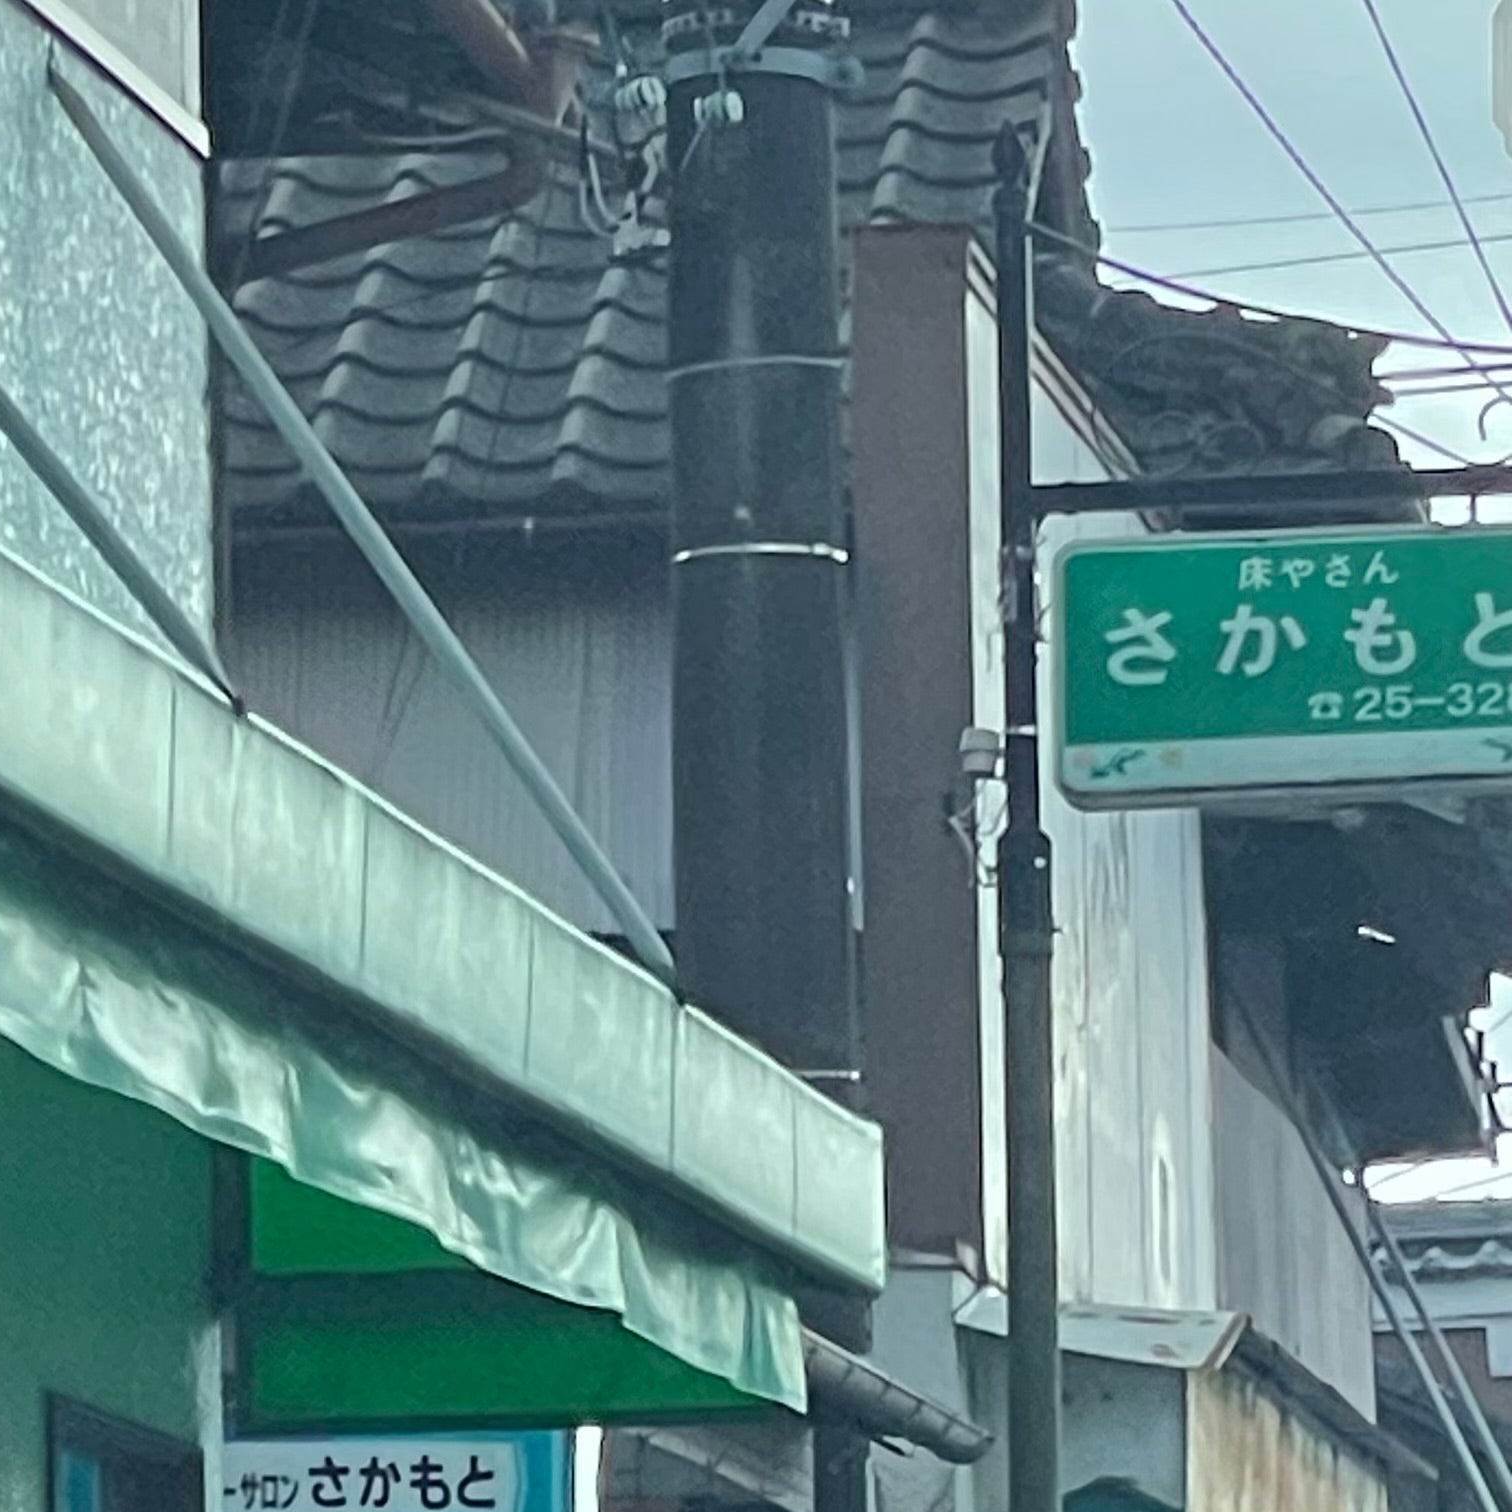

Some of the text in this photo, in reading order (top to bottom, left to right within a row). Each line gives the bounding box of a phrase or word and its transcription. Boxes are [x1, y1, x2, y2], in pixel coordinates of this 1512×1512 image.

[1238, 550, 1399, 590] 床やさん
[1353, 682, 1512, 721] 25-32
